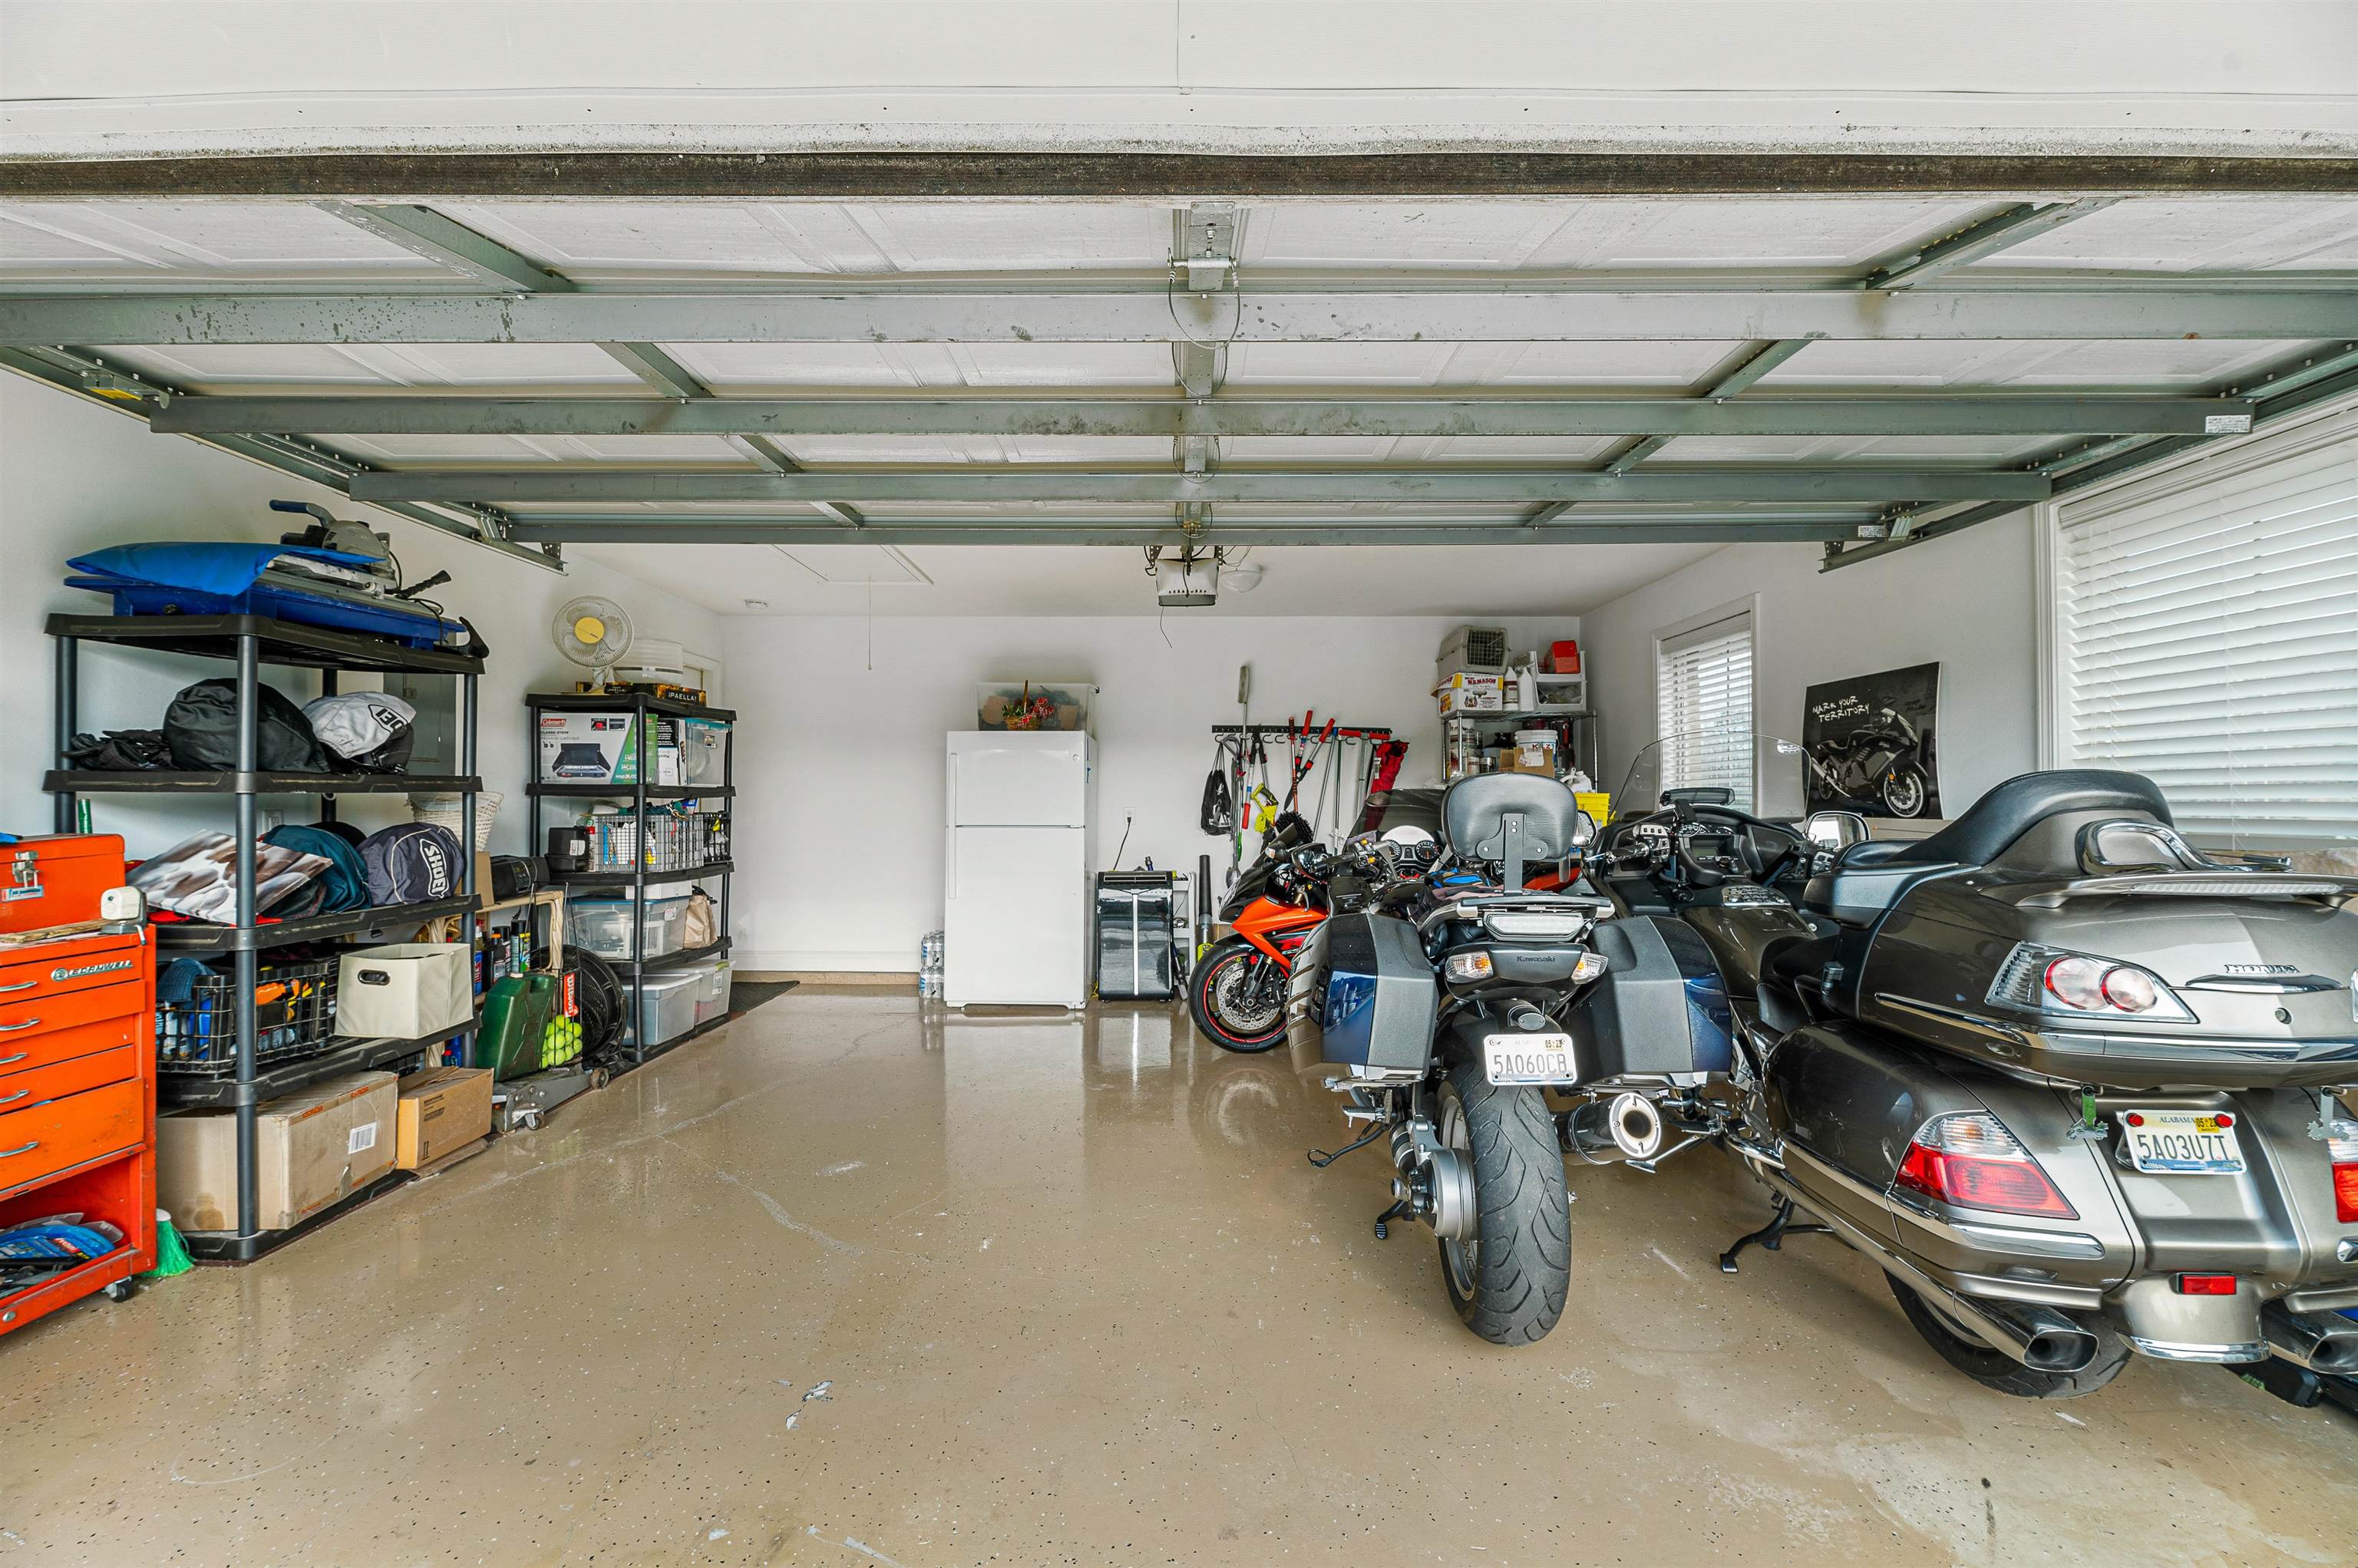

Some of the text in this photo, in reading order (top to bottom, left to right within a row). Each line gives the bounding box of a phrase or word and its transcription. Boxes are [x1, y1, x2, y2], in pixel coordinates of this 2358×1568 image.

[668, 692, 697, 701] ¡PAELLA!
[1812, 695, 1858, 715] MARK YOUR
[1818, 703, 1870, 723] TERRITORY
[424, 845, 447, 894] SHOEI
[2224, 964, 2300, 974] HONDA
[1493, 1054, 1567, 1074] 5A060CB
[2137, 1134, 2230, 1161] 5A03U7T
